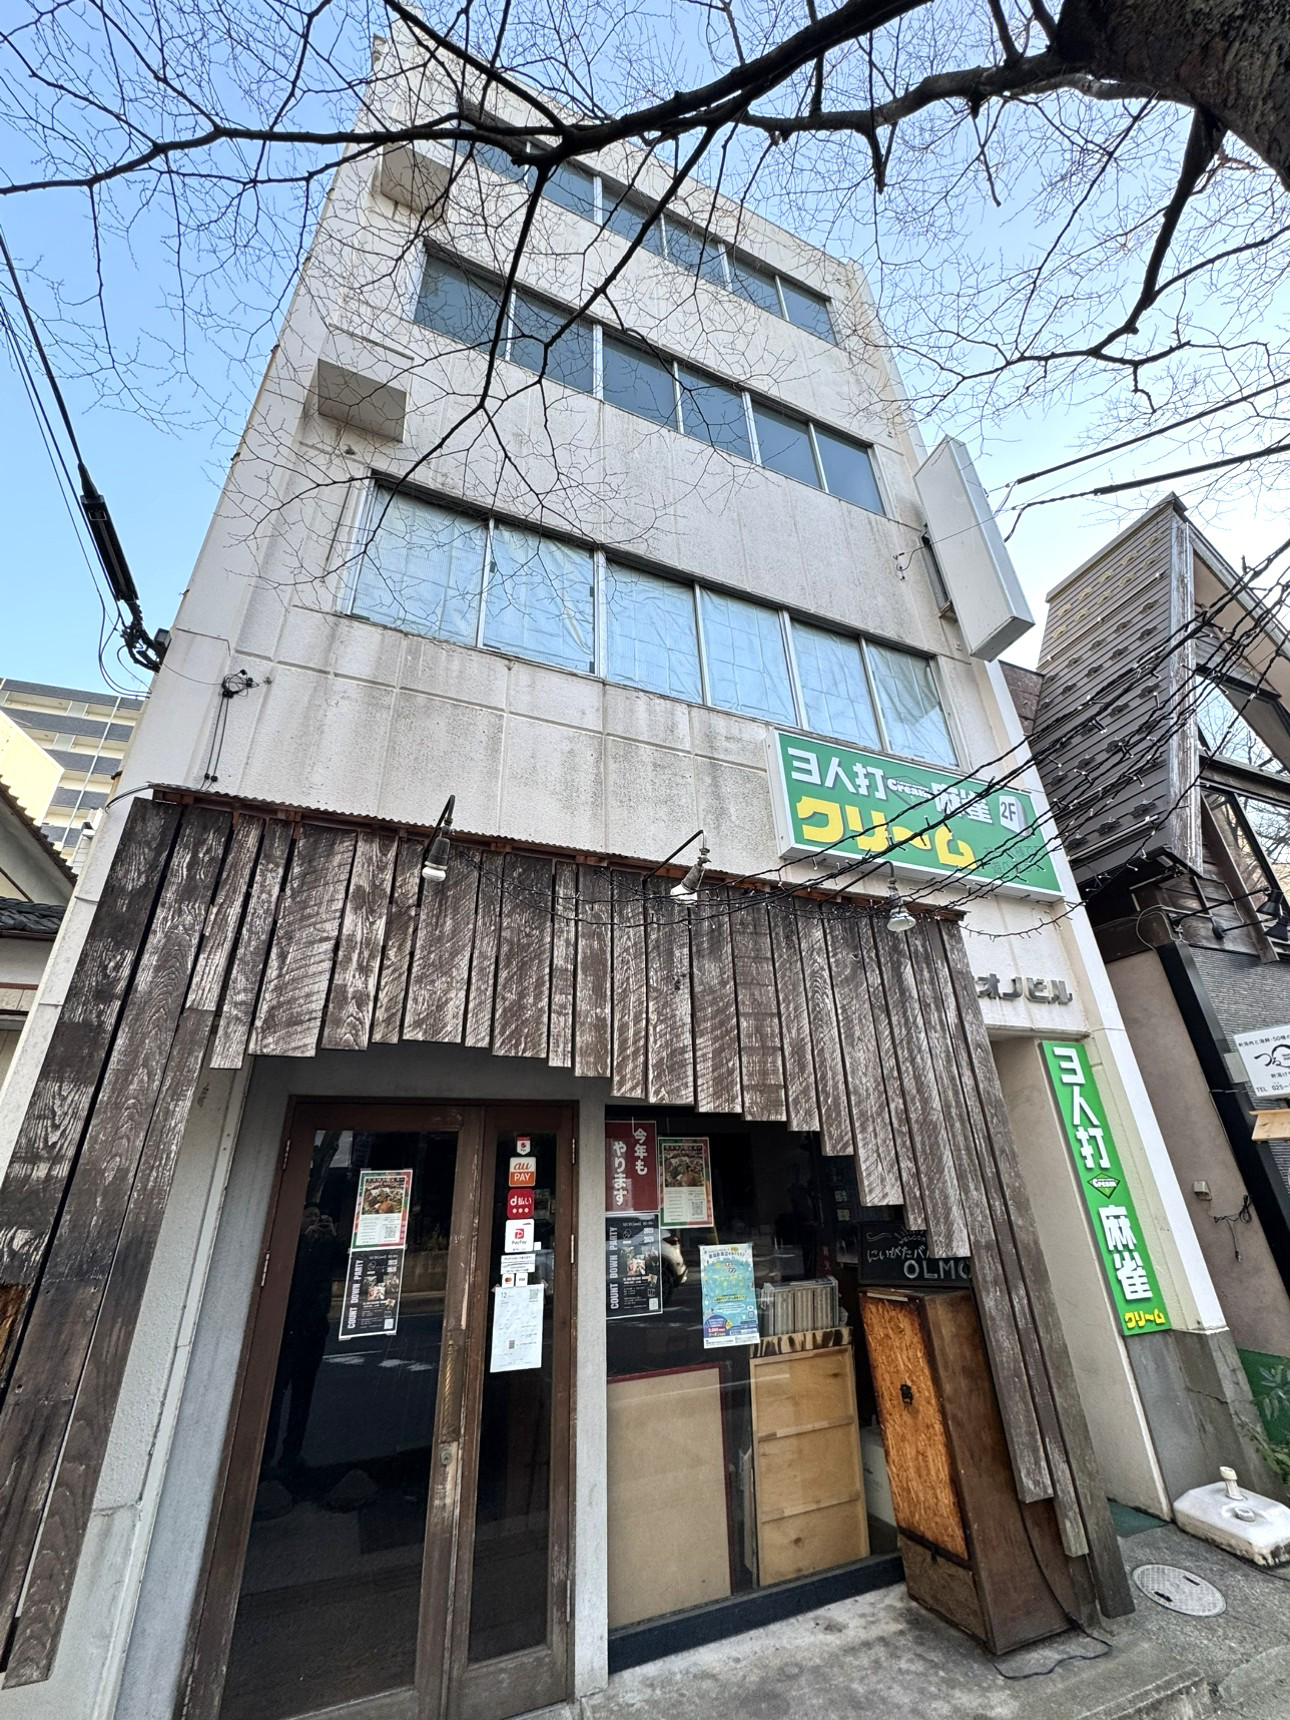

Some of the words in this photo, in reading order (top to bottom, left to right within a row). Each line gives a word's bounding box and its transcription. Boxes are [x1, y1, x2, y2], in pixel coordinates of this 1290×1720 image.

[1000, 801, 1017, 821] 2F
[796, 796, 977, 870] クリーム
[633, 1128, 648, 1176] 今年も
[513, 1162, 532, 1171] au
[514, 1173, 531, 1182] PAY
[612, 1141, 628, 1206] やります
[510, 1196, 532, 1206] d払い
[609, 1227, 618, 1251] PARTY
[1098, 1204, 1153, 1300] 麻雀
[353, 1260, 364, 1281] PARTY
[609, 1255, 618, 1279] DOWN
[350, 1283, 361, 1304] DOWN
[610, 1283, 619, 1310] COUNT
[347, 1307, 358, 1329] COUNT
[1124, 1308, 1165, 1329] クリーム
